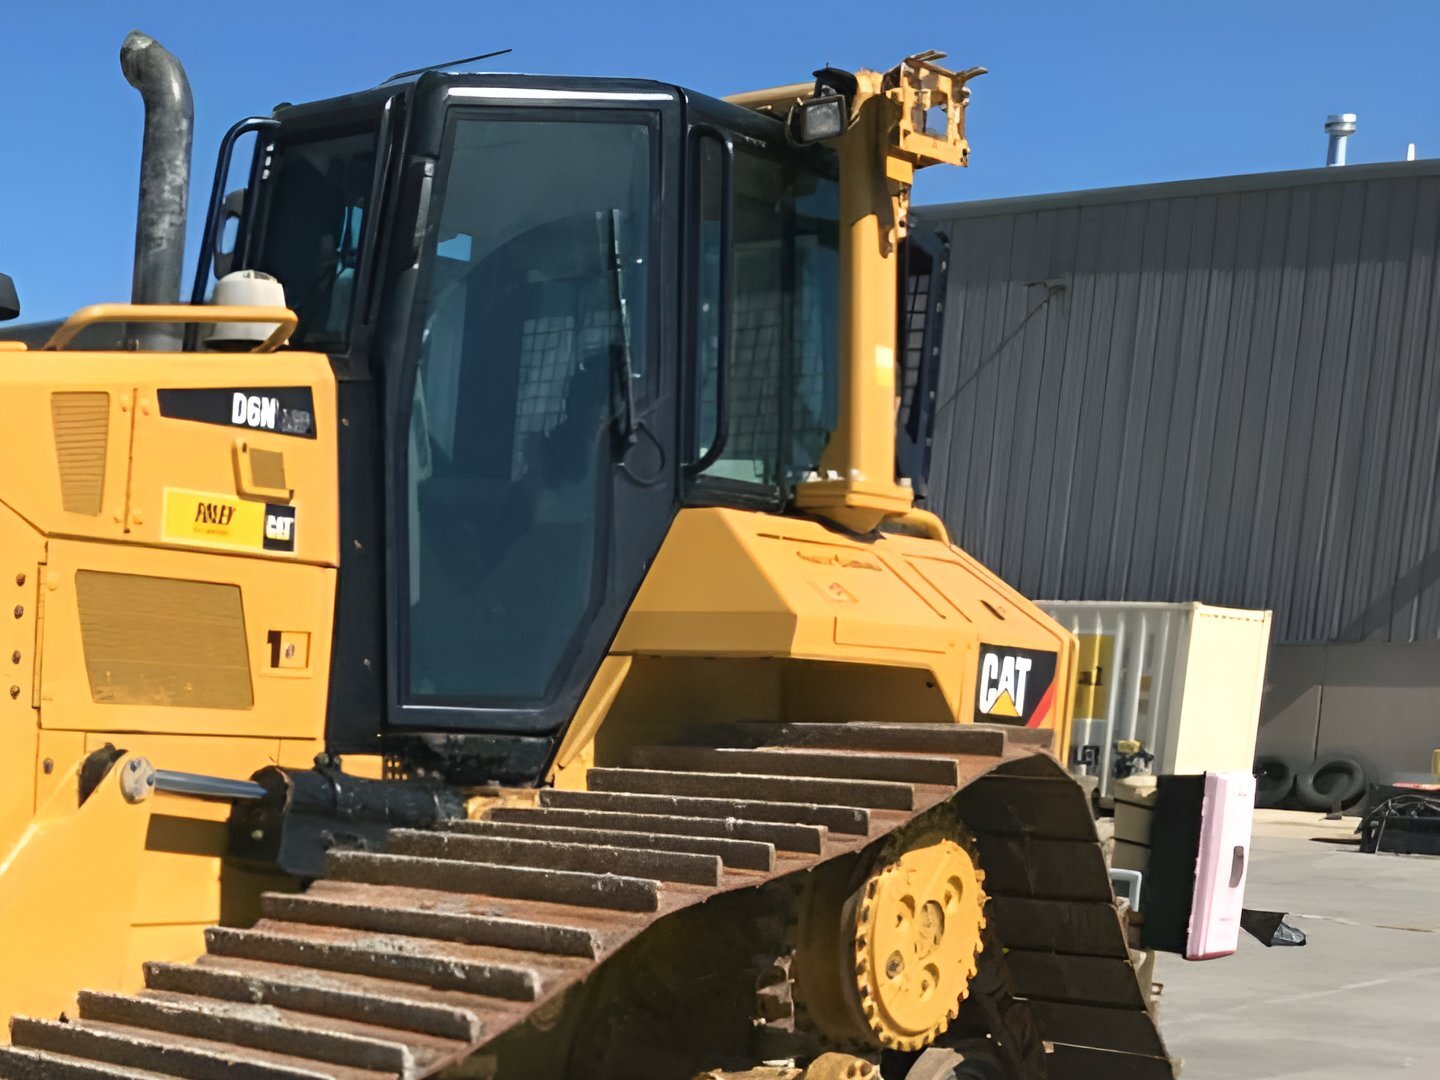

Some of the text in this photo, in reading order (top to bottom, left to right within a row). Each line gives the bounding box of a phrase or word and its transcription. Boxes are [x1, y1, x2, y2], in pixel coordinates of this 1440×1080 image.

[232, 392, 278, 429] D6N
[266, 514, 294, 541] CAT
[979, 652, 1032, 717] CAT
